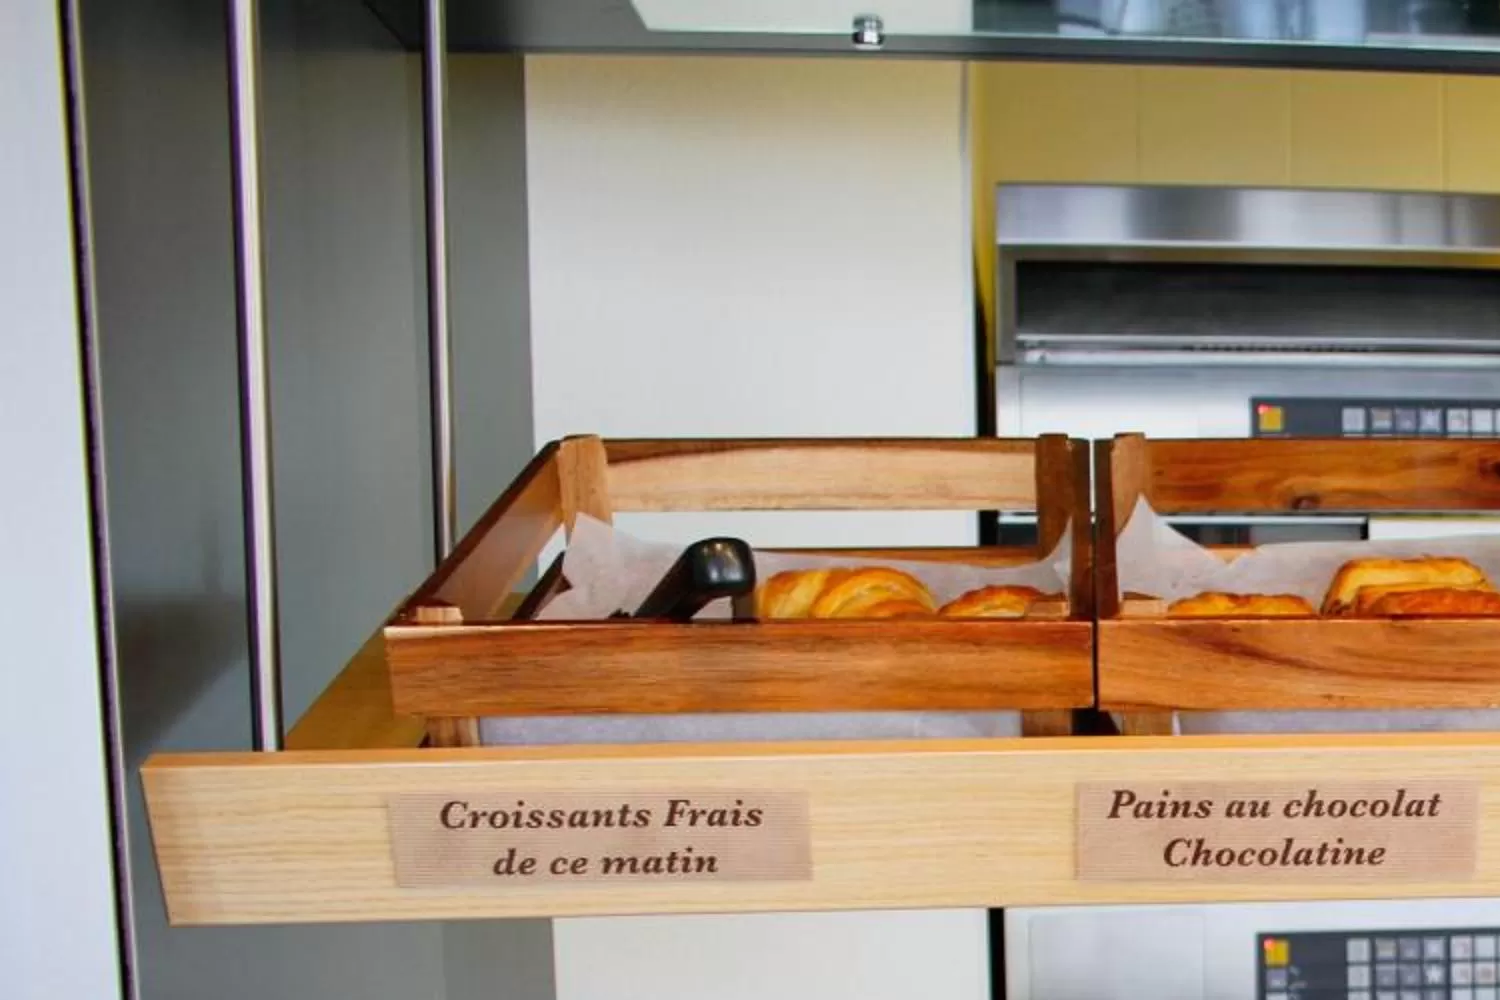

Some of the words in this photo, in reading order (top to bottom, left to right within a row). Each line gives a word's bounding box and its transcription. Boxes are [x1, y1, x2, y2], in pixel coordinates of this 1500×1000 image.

[439, 800, 652, 829] Croissants
[663, 799, 764, 827] Frais
[1106, 789, 1213, 819] Pains
[1225, 799, 1270, 818] au
[1283, 788, 1442, 818] chocolat
[493, 848, 537, 875] de
[550, 856, 589, 875] ce
[602, 847, 718, 874] matin
[1162, 837, 1387, 867] Chocolatine
